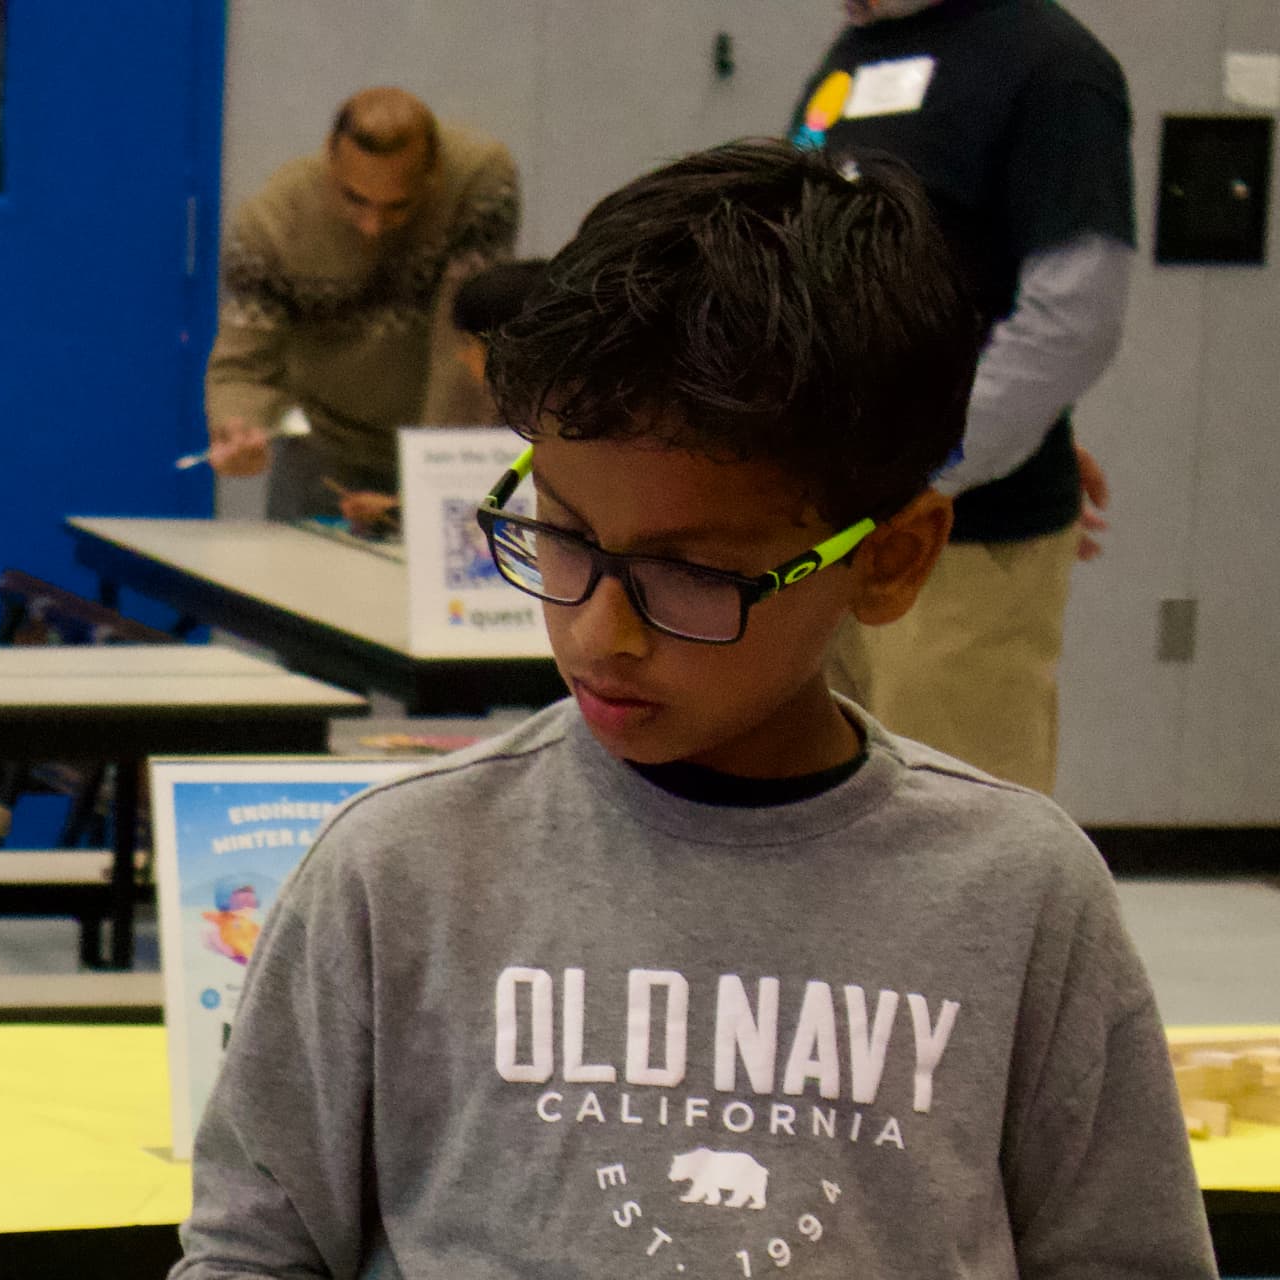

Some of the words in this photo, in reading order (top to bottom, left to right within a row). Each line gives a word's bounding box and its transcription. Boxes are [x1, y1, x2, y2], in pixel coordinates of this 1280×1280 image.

[470, 607, 534, 628] quest
[212, 828, 294, 855] WINTER
[495, 966, 689, 1088] OLD
[713, 974, 961, 1113] NAVY
[536, 1091, 906, 1150] CALIFORNIA
[596, 1162, 686, 1273] EST.
[734, 1178, 842, 1279] 1994
